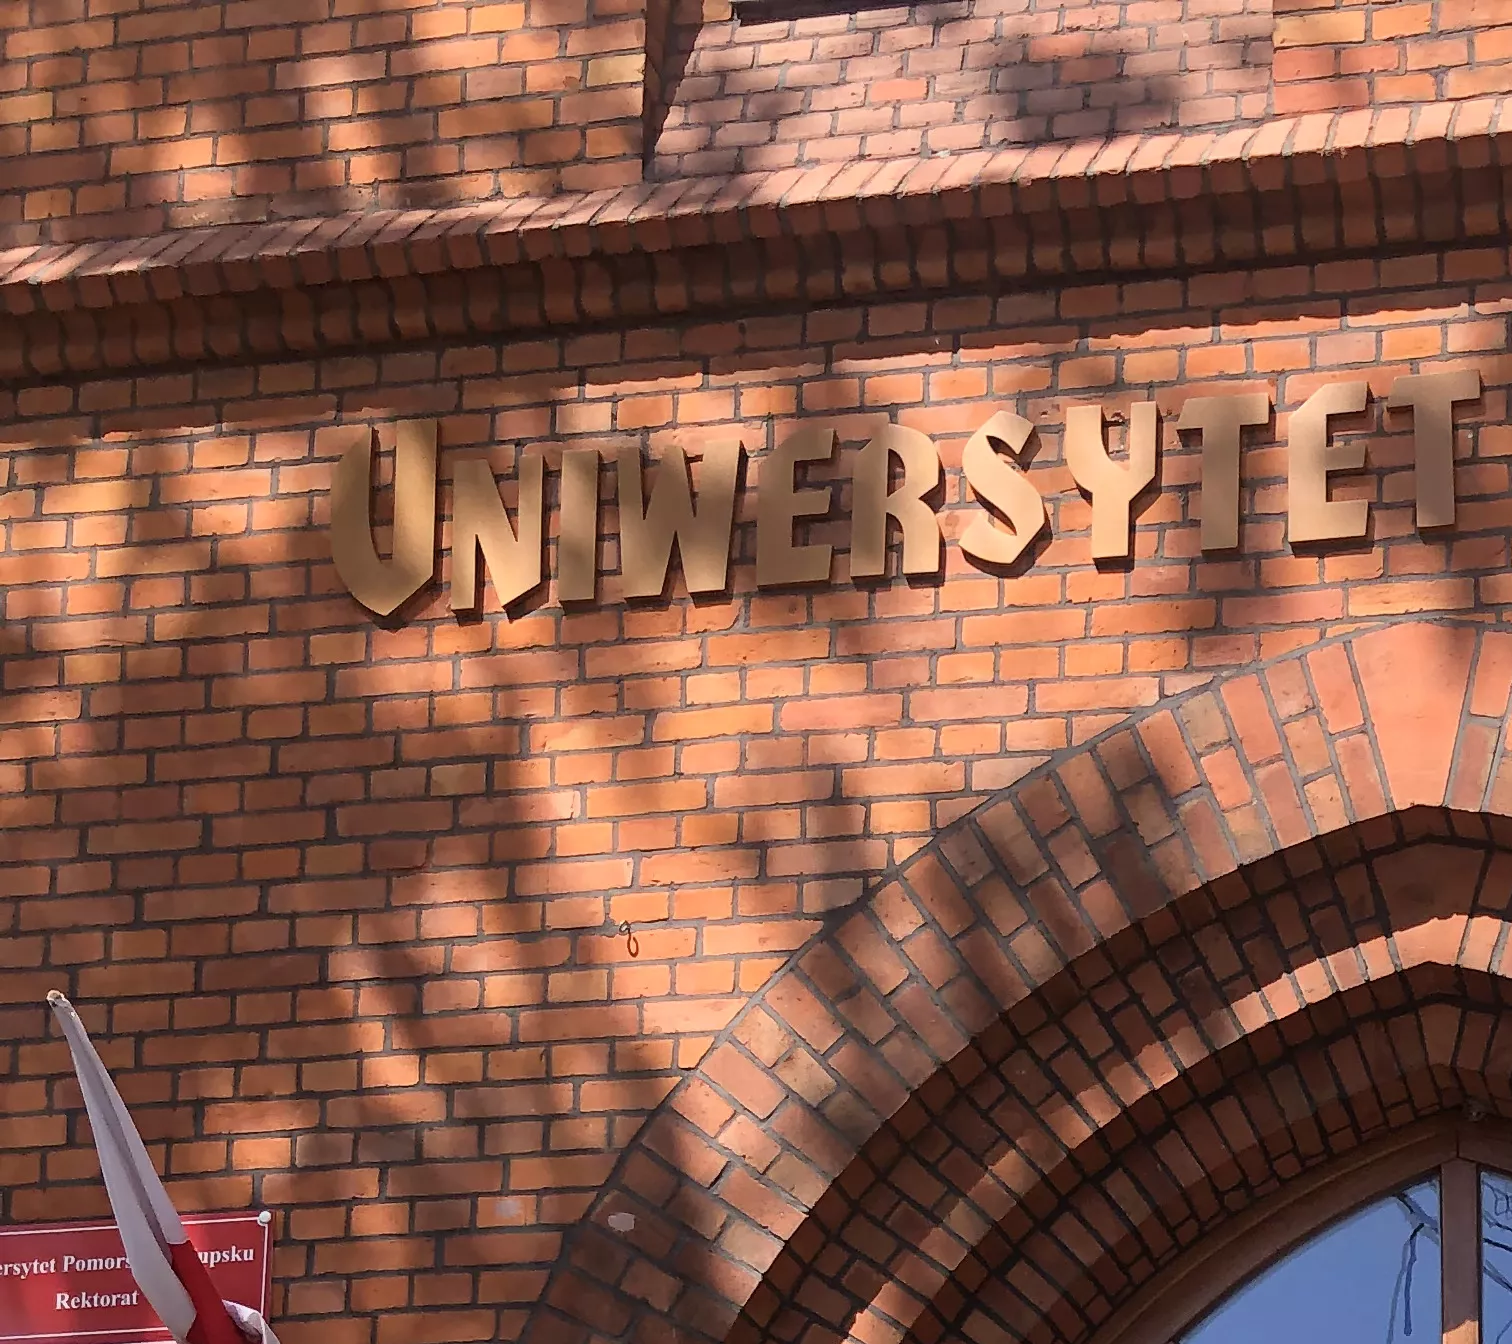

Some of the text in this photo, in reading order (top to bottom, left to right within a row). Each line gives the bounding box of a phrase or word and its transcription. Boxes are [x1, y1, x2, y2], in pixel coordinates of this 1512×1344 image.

[330, 369, 1483, 618] UNIWERSYTET
[62, 1254, 132, 1273] Pomors
[197, 1245, 254, 1268] upsku
[55, 1289, 140, 1310] Rektorat
